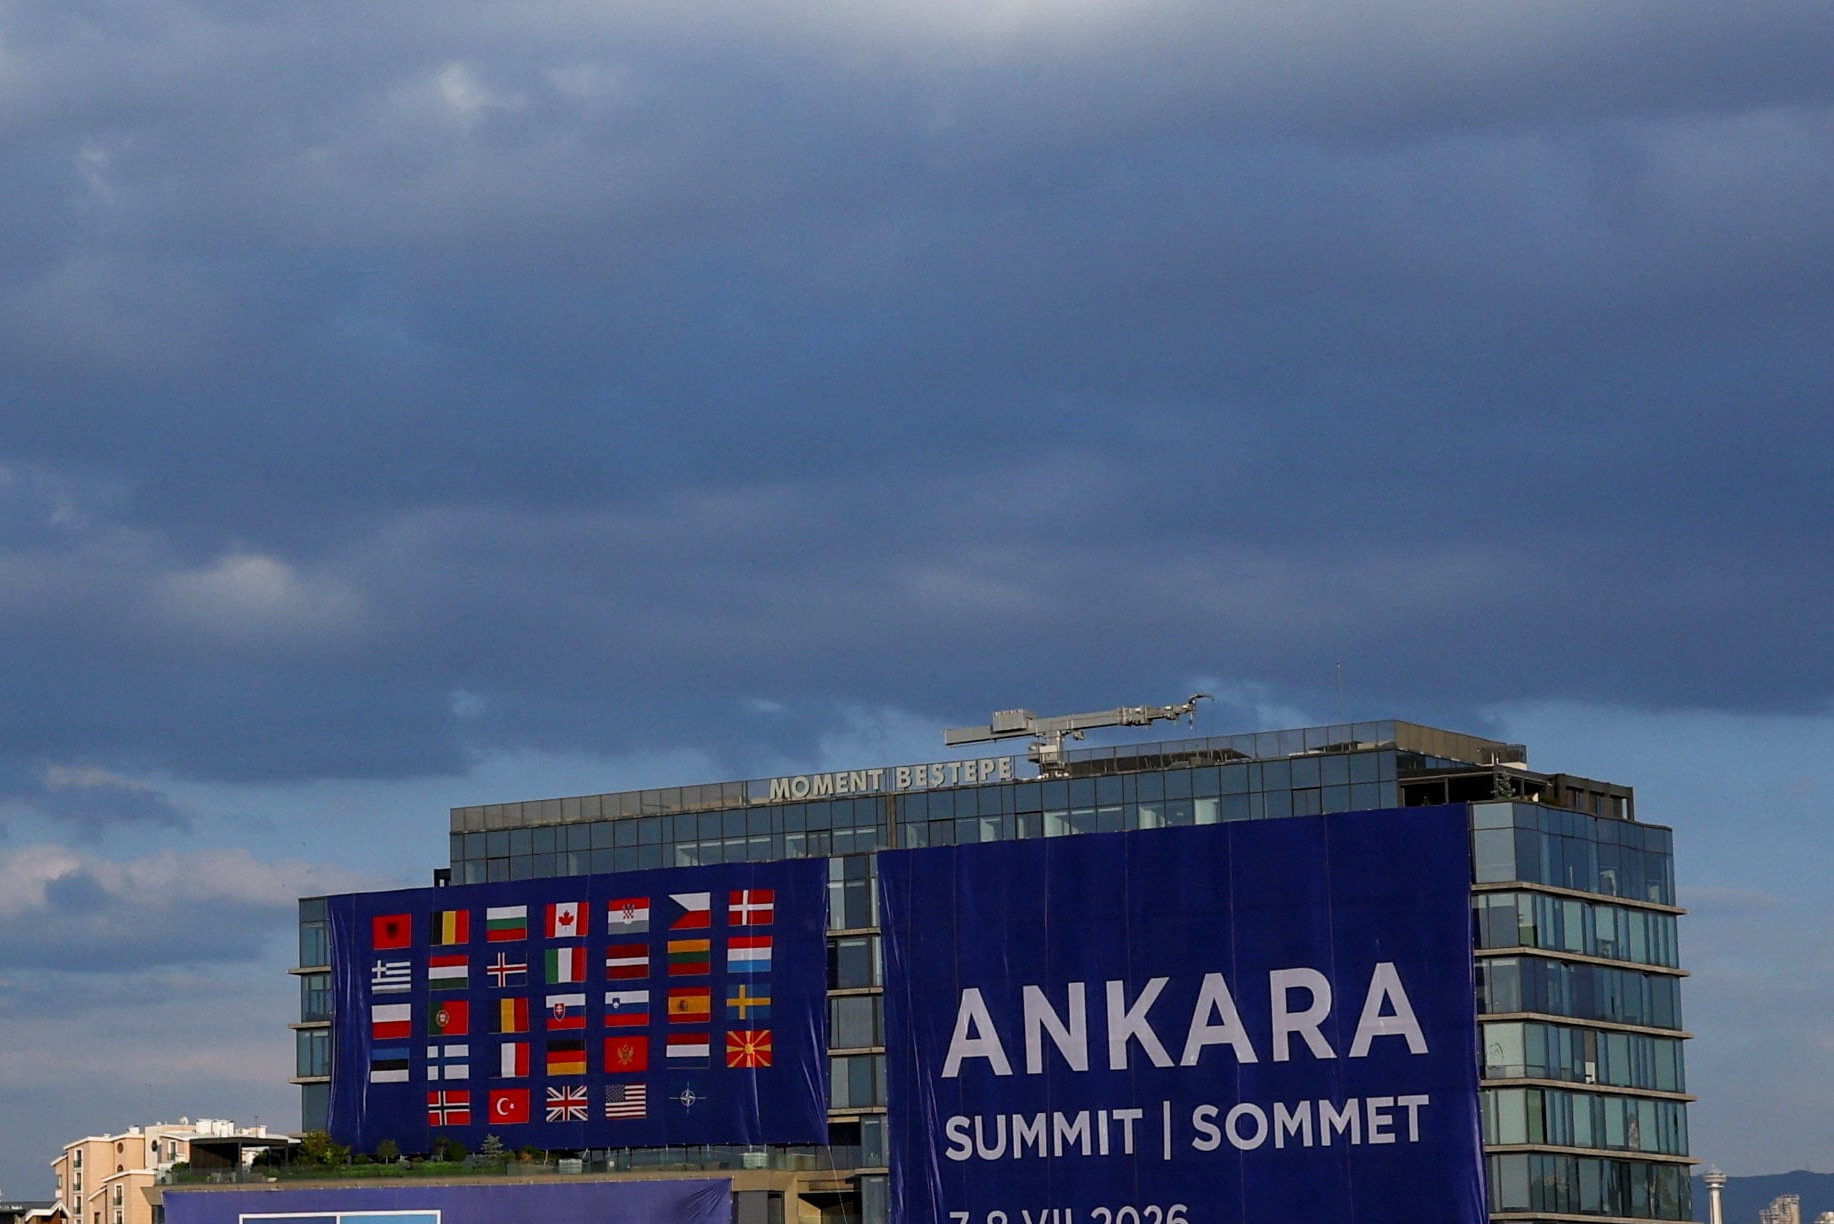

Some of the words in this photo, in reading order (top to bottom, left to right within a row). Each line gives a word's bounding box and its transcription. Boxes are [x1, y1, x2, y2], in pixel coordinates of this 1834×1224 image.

[770, 769, 884, 802] MOMENT
[896, 757, 1014, 788] BEŞTEPE
[941, 962, 1428, 1078] ANKARA
[945, 1108, 1143, 1161] SUMMIT
[1191, 1095, 1430, 1152] SOMMET
